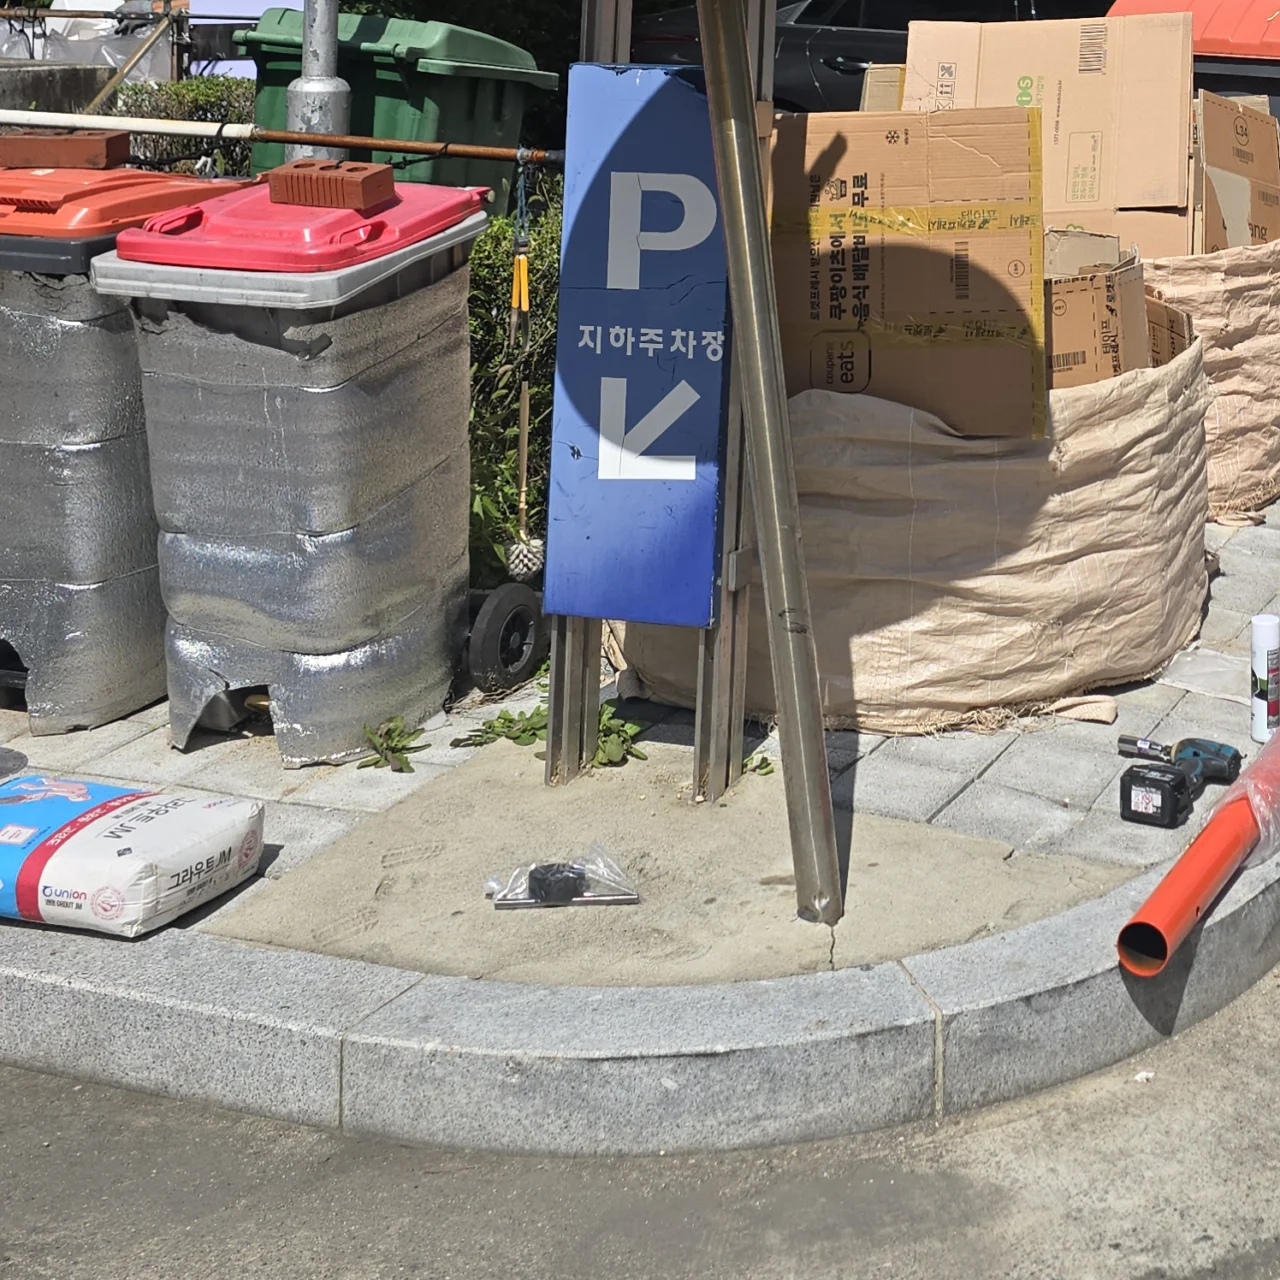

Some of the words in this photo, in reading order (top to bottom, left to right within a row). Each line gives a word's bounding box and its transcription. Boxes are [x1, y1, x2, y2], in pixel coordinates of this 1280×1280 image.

[851, 172, 870, 208] 무료
[606, 171, 718, 290] P
[809, 238, 821, 268] 받으신
[828, 212, 848, 321] 쿠팡이츠에서
[809, 270, 821, 321] 로켓프레시
[851, 284, 870, 321] 음식
[577, 324, 726, 362] 지하주차장
[836, 340, 855, 384] eats
[54, 888, 87, 901] union
